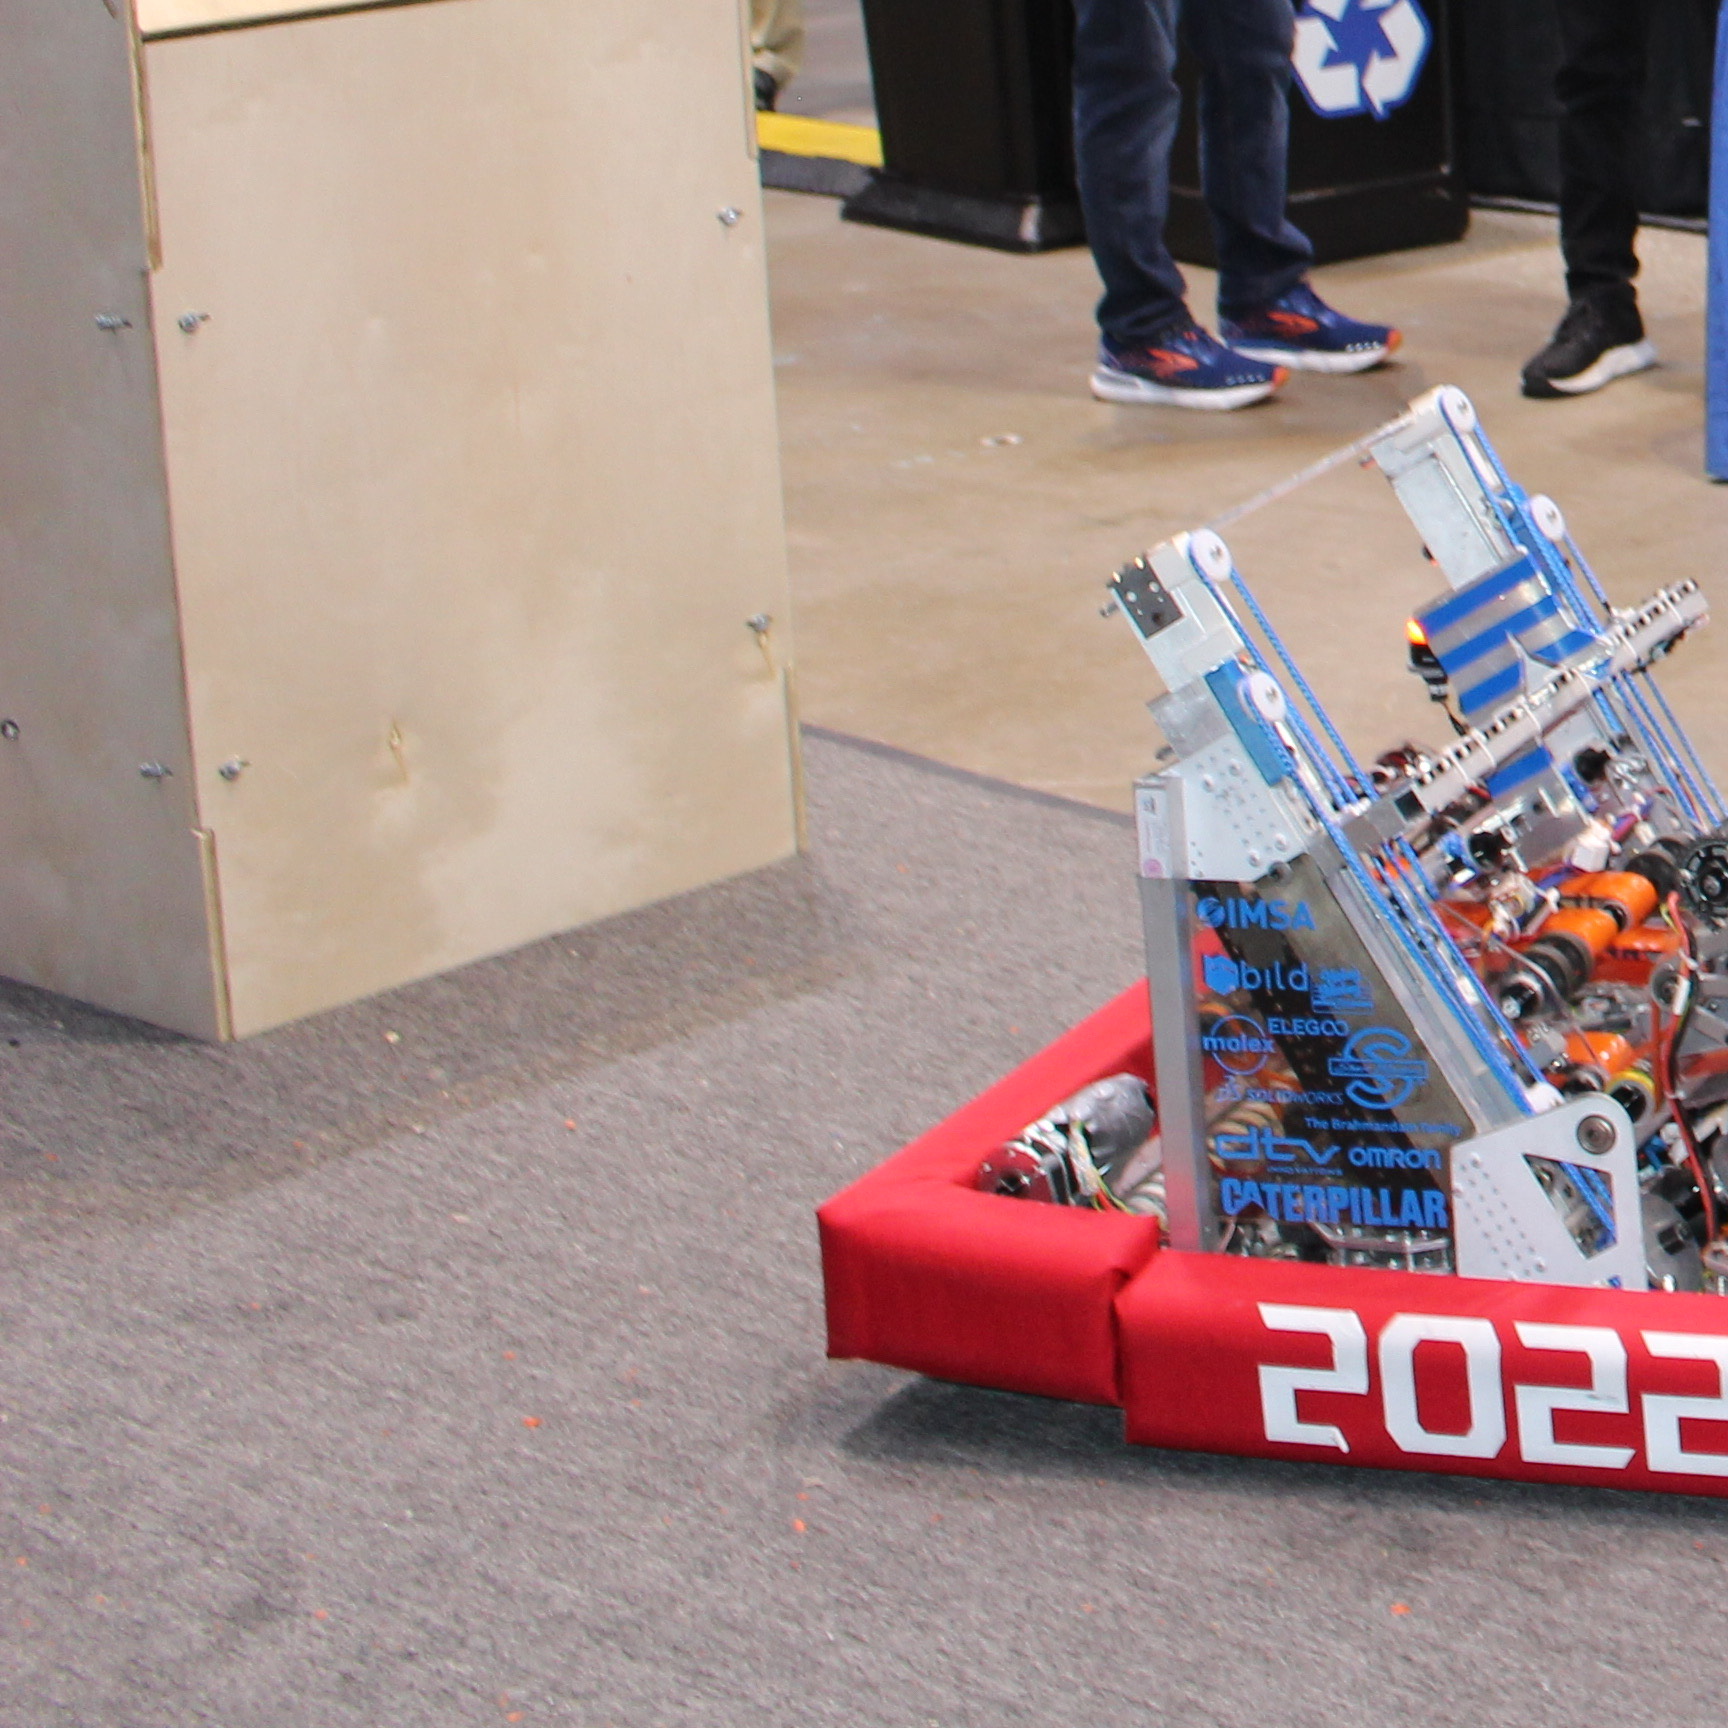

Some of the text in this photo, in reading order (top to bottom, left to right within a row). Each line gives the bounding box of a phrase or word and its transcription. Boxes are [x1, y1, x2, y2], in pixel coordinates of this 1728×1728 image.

[1227, 897, 1316, 931] IMSA
[1241, 960, 1309, 992] bild
[1267, 1015, 1349, 1038] ELEGOO
[1202, 1034, 1276, 1054] molex
[1245, 1087, 1345, 1106] SOLIDWORKS
[1304, 1116, 1330, 1131] The
[1215, 1126, 1342, 1167] dtv
[1219, 1176, 1449, 1229] CATERPILLAR
